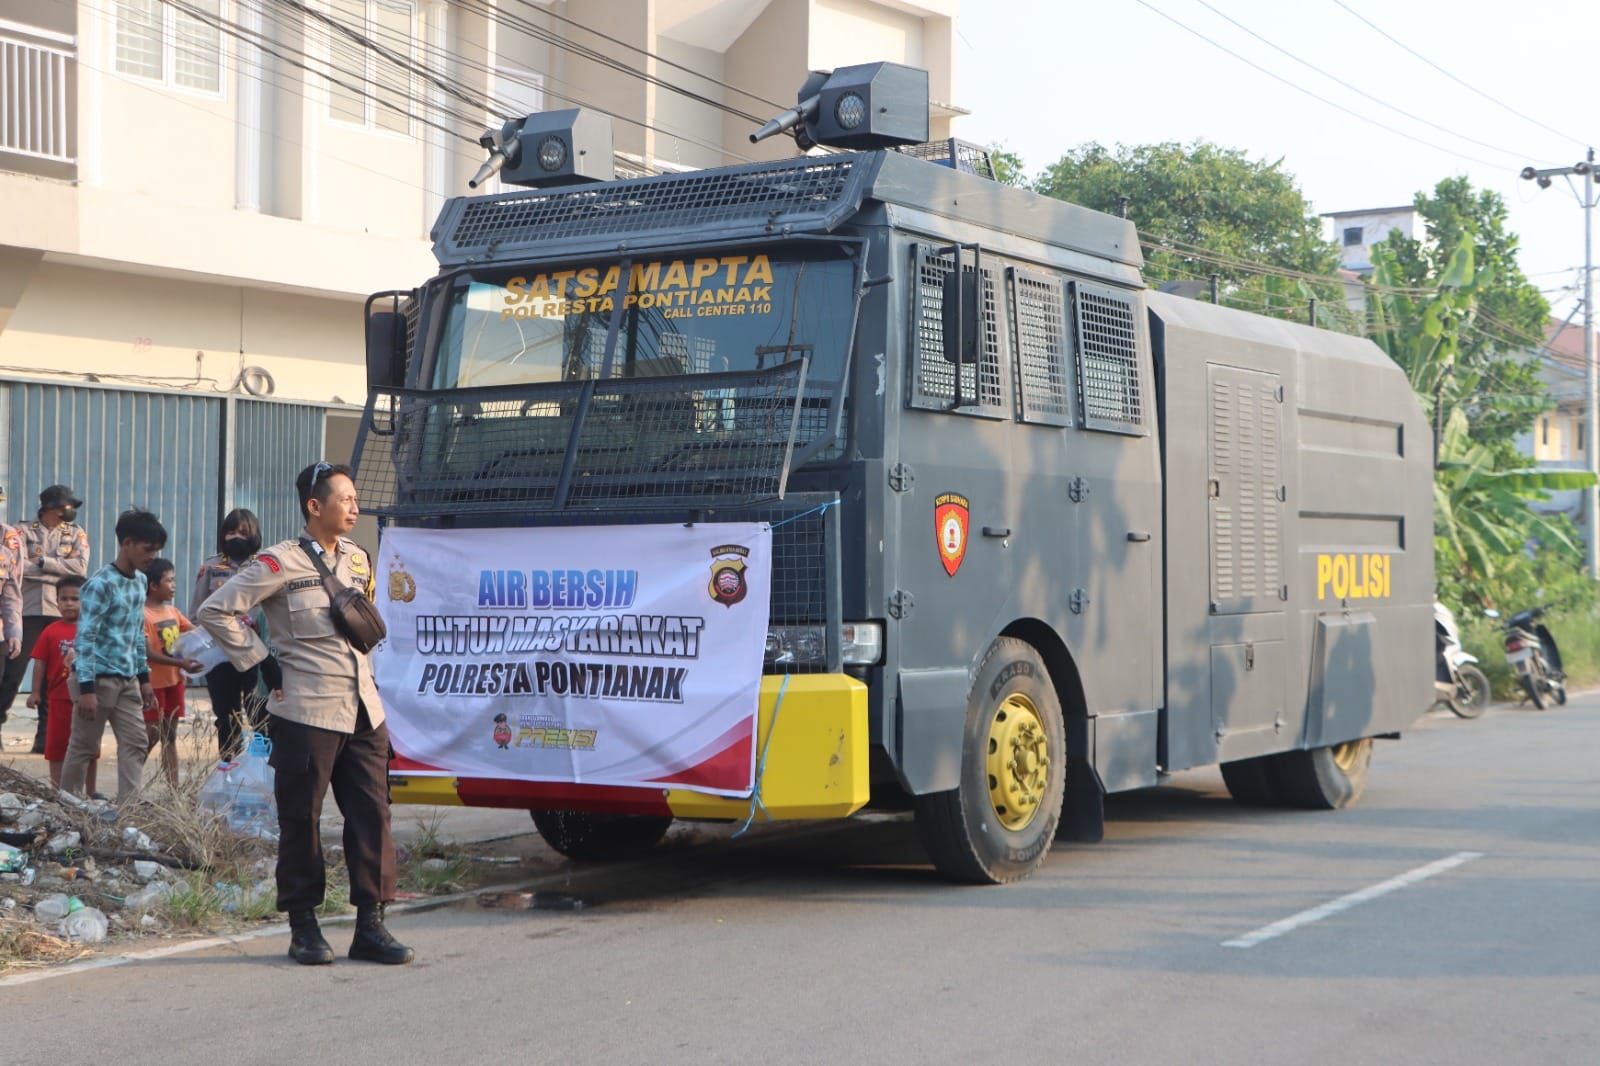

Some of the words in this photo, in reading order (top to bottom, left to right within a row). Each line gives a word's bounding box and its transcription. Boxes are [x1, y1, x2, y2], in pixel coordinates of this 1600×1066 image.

[501, 298, 614, 322] POLRESTA
[623, 286, 772, 310] PONTIANAK
[664, 308, 694, 319] CALL
[697, 304, 745, 317] CENTER
[751, 303, 771, 314] 110
[478, 569, 527, 608] AIR
[532, 569, 638, 610] BERSIH
[1317, 553, 1391, 600] POLISI
[416, 615, 509, 655] UNTUK
[505, 615, 705, 659] MASYARAKAT
[417, 662, 533, 696] POLRESTA
[535, 662, 688, 703] PONTIANAK
[514, 727, 598, 750] PRESISI
